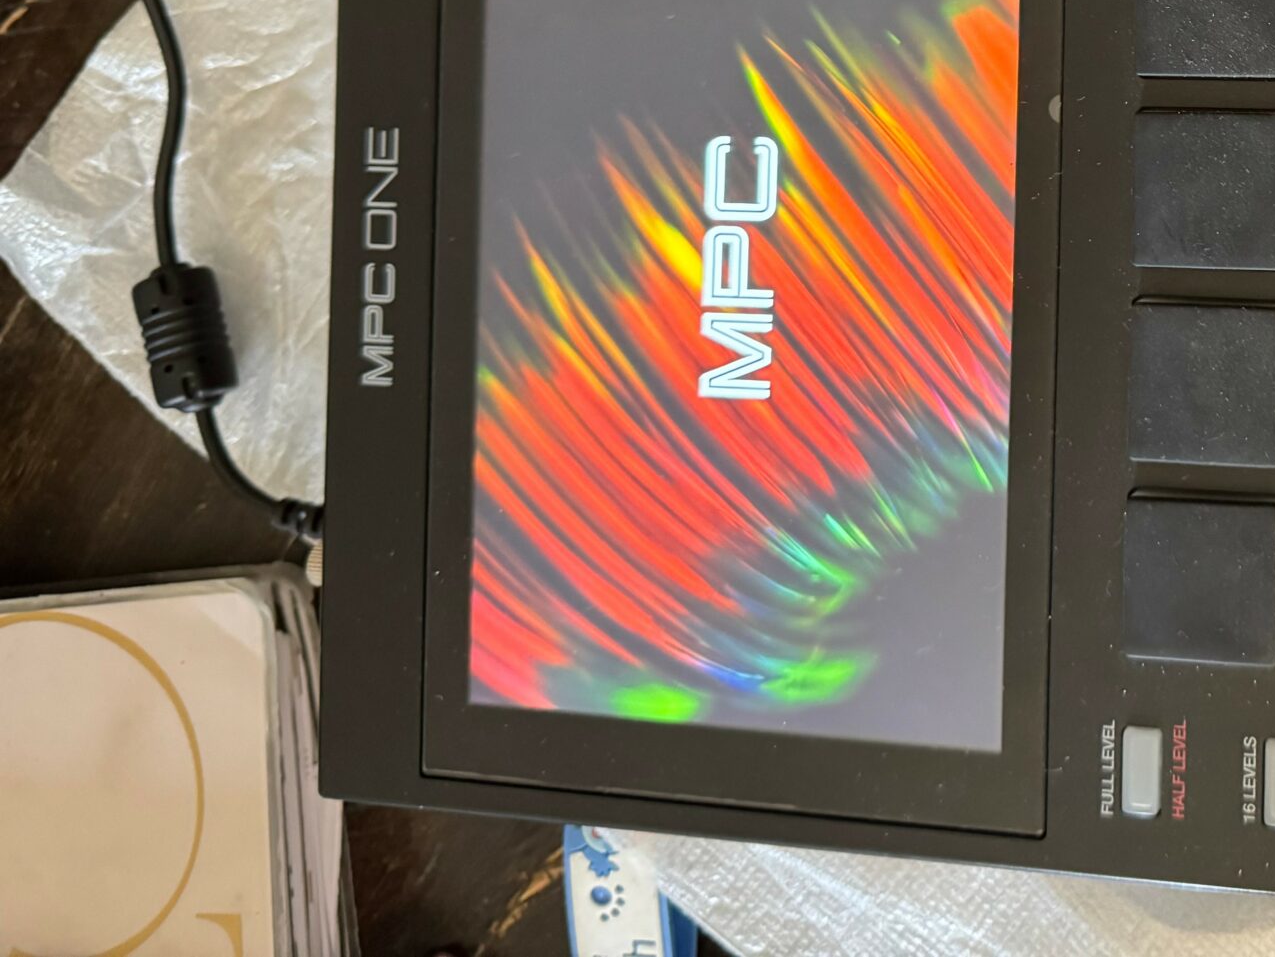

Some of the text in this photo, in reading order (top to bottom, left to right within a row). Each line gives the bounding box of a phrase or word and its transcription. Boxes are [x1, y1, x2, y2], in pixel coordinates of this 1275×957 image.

[360, 127, 399, 387] MPC ONE
[698, 135, 778, 399] MPC
[1100, 719, 1115, 816] FULL LEVEL
[1172, 718, 1186, 819] HALF LEVEL
[1243, 736, 1257, 825] 16 LEVELS
